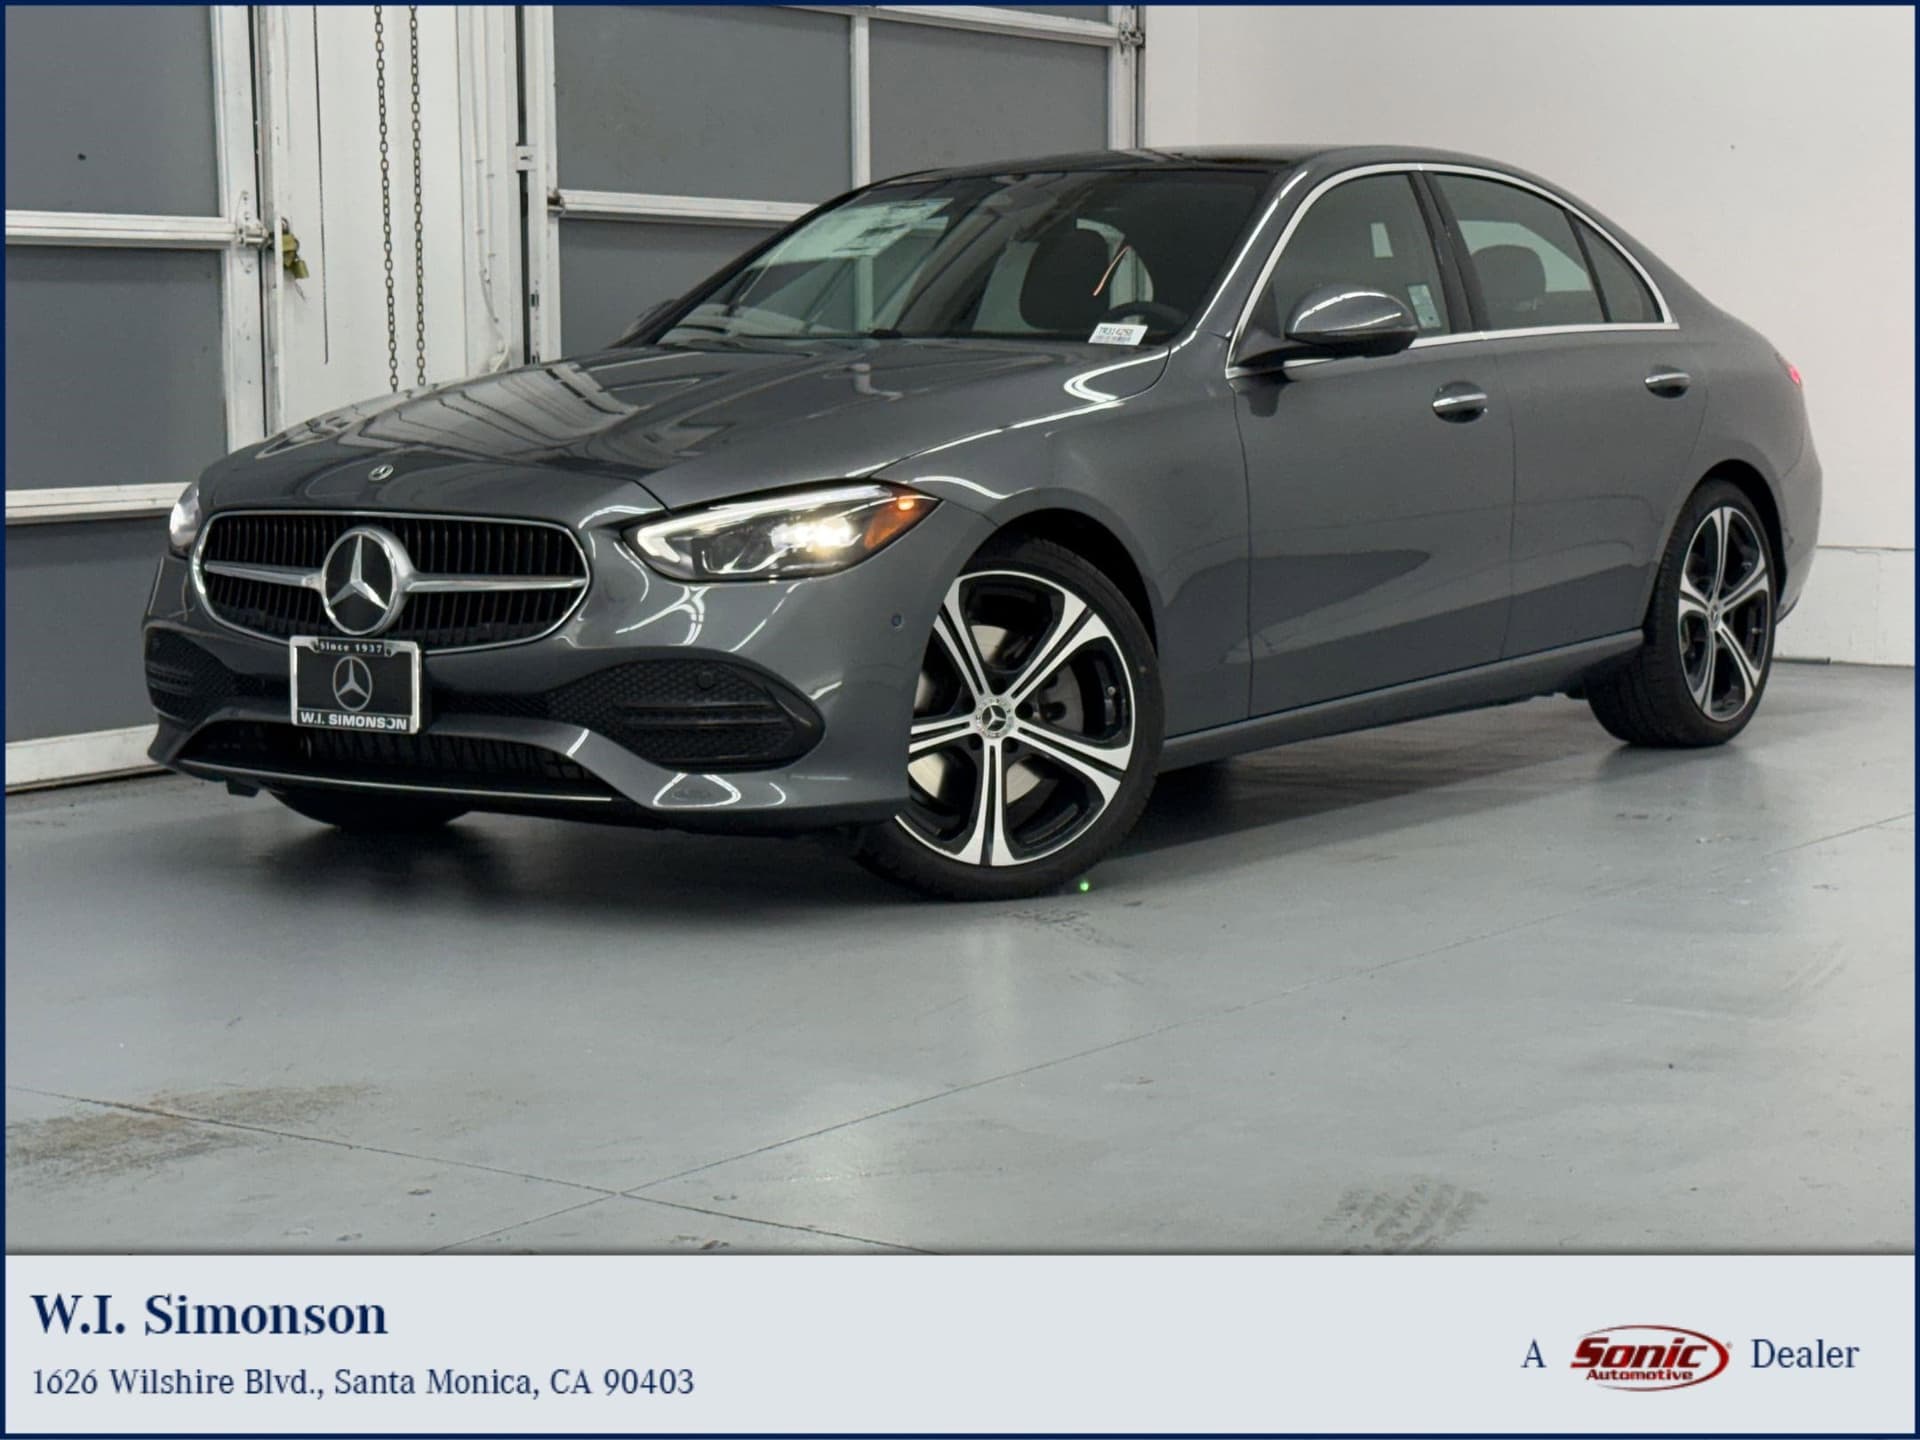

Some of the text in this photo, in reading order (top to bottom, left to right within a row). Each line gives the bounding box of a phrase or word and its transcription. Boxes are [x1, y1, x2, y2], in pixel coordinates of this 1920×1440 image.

[320, 640, 383, 654] Since 1937
[300, 711, 407, 731] W.I. SIMONSON
